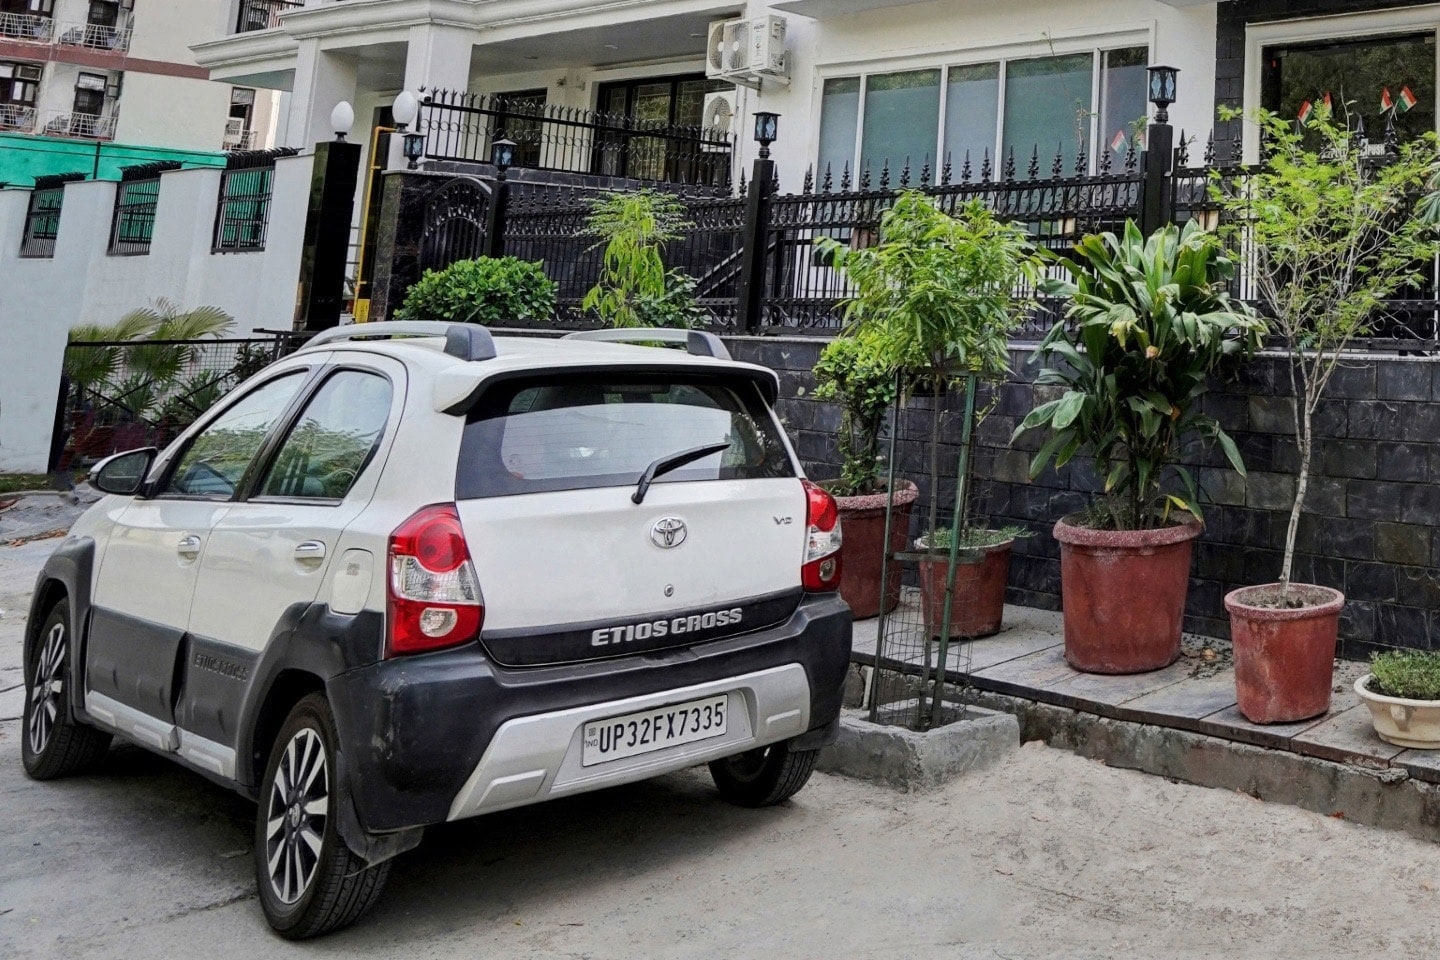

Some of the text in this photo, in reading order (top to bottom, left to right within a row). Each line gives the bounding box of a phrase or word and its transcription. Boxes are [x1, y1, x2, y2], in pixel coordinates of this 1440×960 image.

[1367, 143, 1386, 156] PUSH
[591, 607, 743, 647] ETIOS CROSS
[599, 701, 724, 753] UP32FX7335
